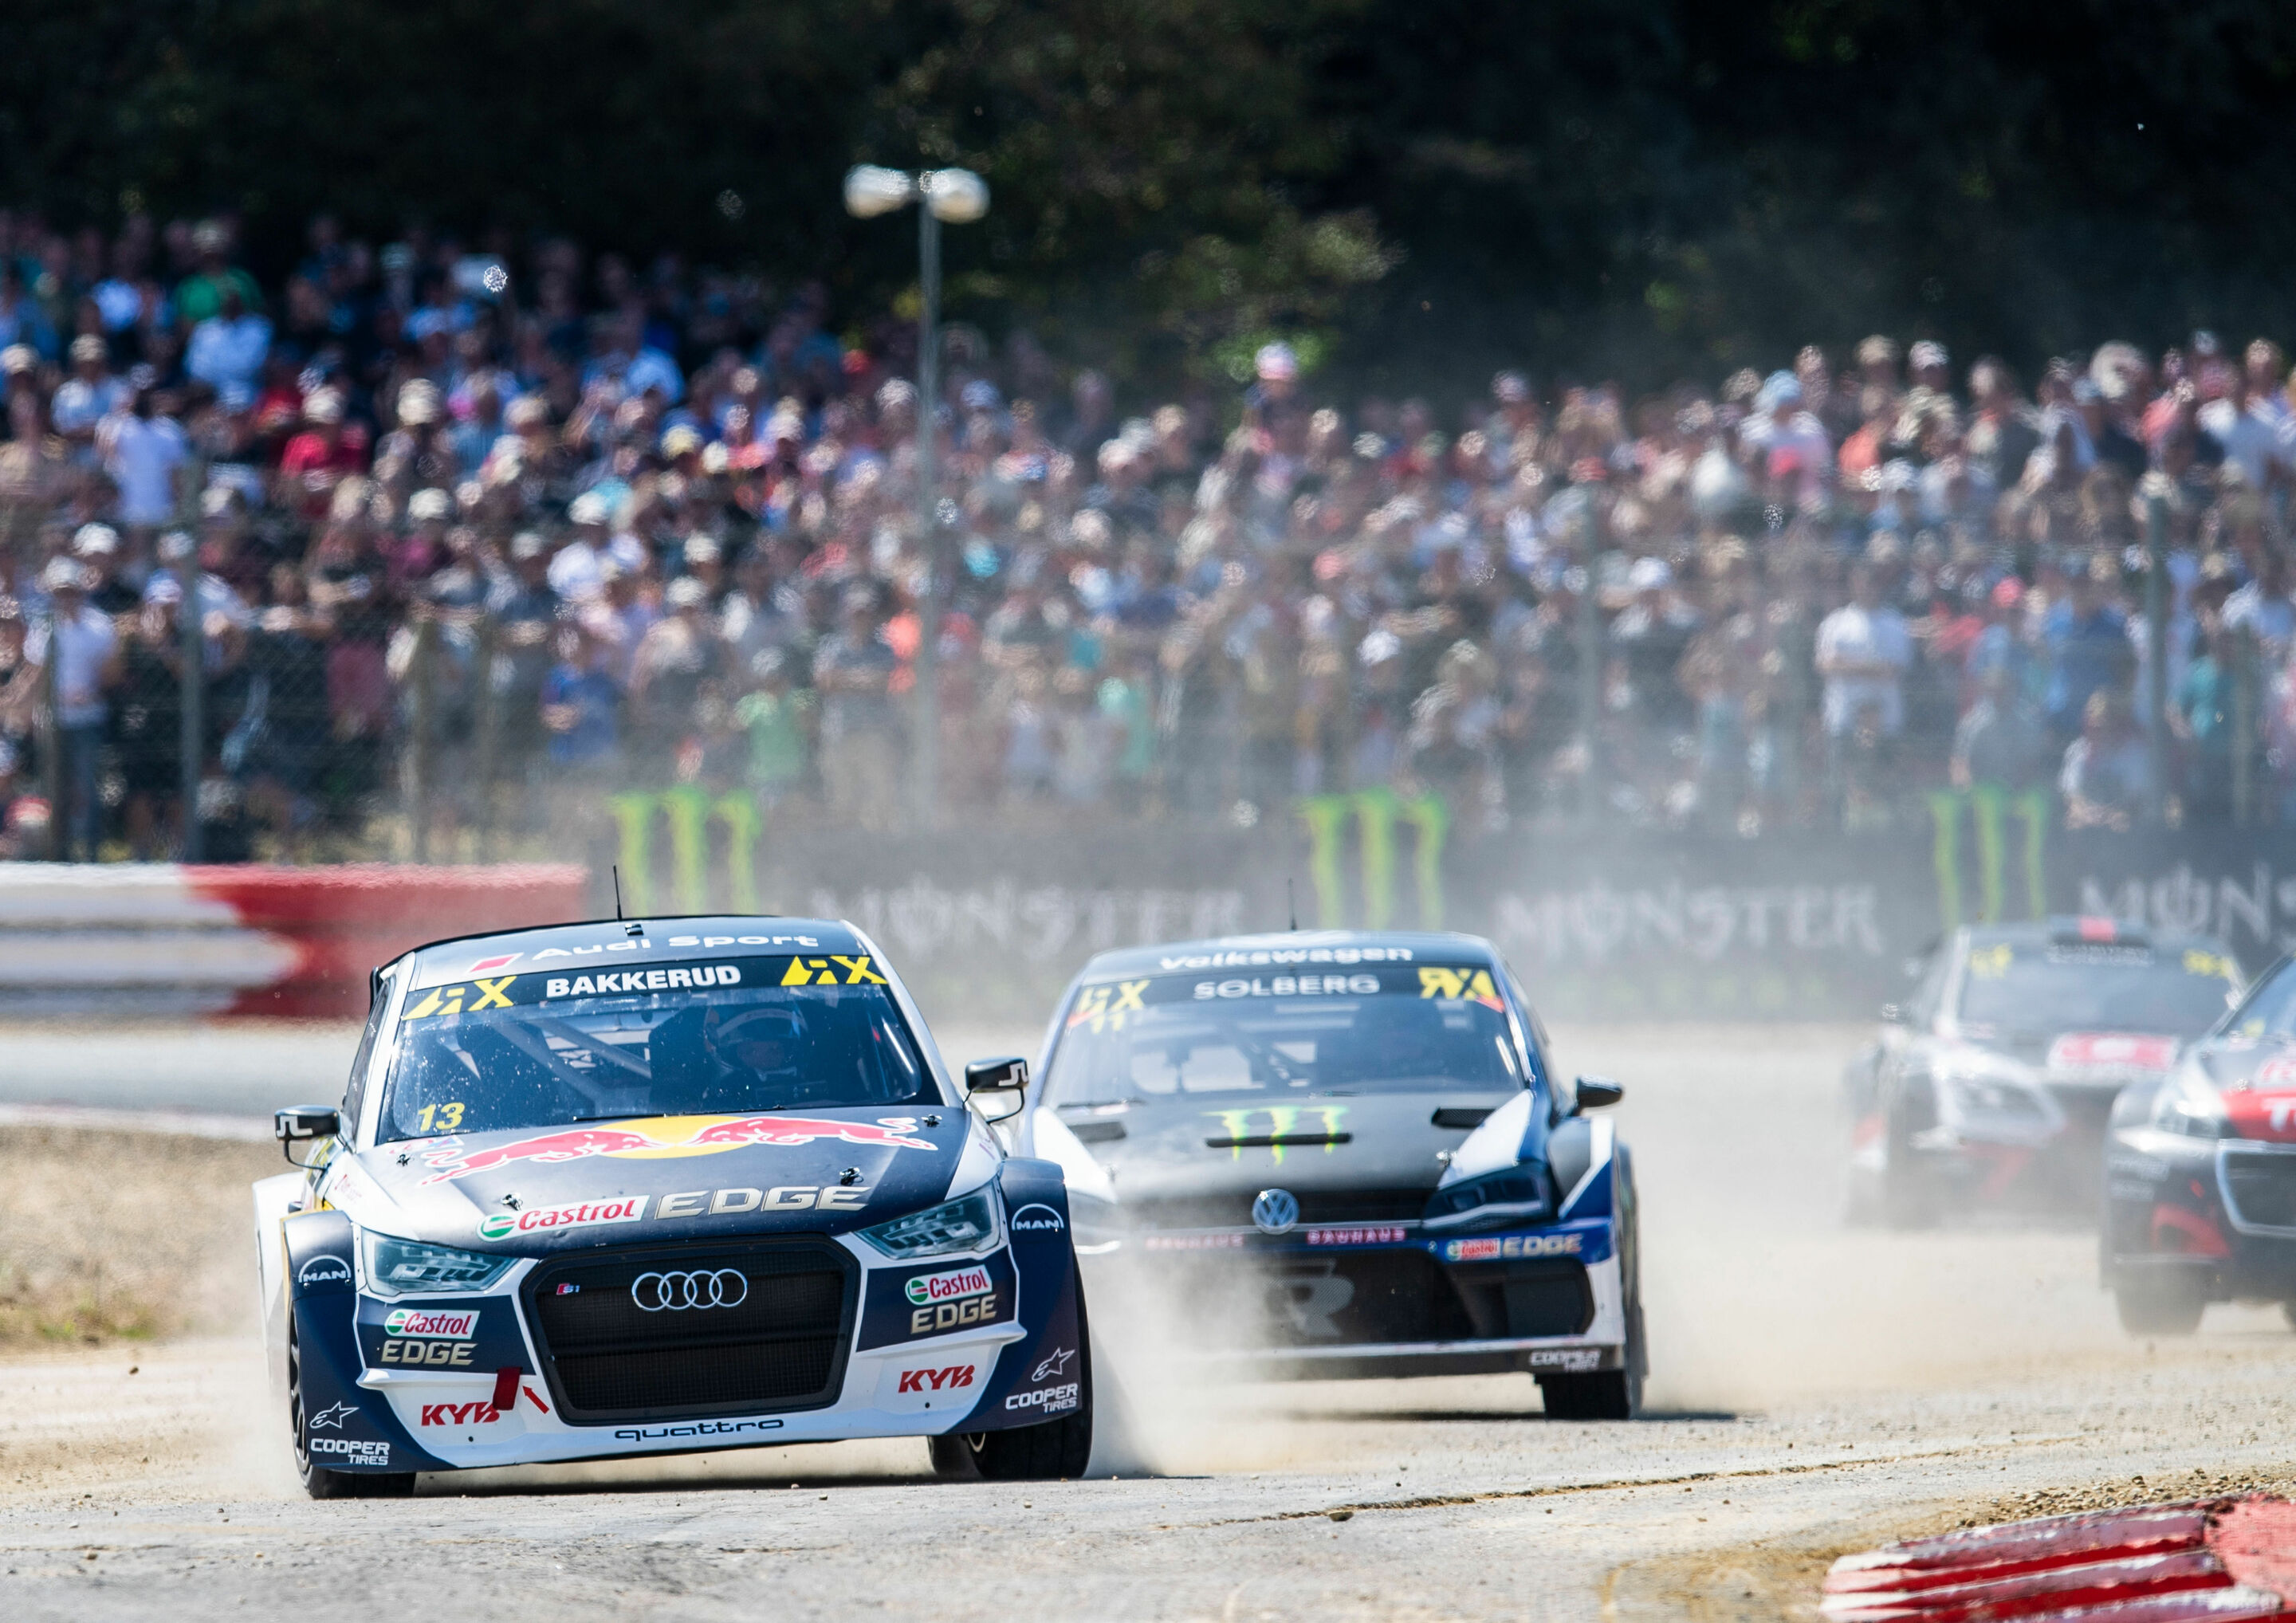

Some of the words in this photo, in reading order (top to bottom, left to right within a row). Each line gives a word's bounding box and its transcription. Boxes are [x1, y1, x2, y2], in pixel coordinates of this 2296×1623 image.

[532, 938, 651, 961] Audi
[668, 934, 820, 948] Sport
[1160, 948, 1413, 970] Volkswagen
[547, 965, 741, 997] BAKKERUD
[1193, 974, 1381, 1000] SOLBERG
[418, 1102, 466, 1133] 13
[518, 1199, 636, 1231] Castrol
[654, 1185, 879, 1220] EDGE
[1014, 1220, 1060, 1231] MAN
[1307, 1227, 1406, 1247] BAUHAUS
[1502, 1233, 1583, 1258] EDGE
[303, 1270, 347, 1283] MAN
[929, 1268, 989, 1300] Castrol
[403, 1312, 473, 1336] Castrol
[910, 1294, 998, 1335] EDGE
[380, 1340, 478, 1366] EDGE
[898, 1364, 976, 1393] KYB
[1005, 1382, 1079, 1410] COOPER
[1043, 1396, 1078, 1413] TIRES
[614, 1418, 784, 1442] quattro
[310, 1438, 391, 1456] COOPER
[348, 1453, 390, 1466] TIRES
